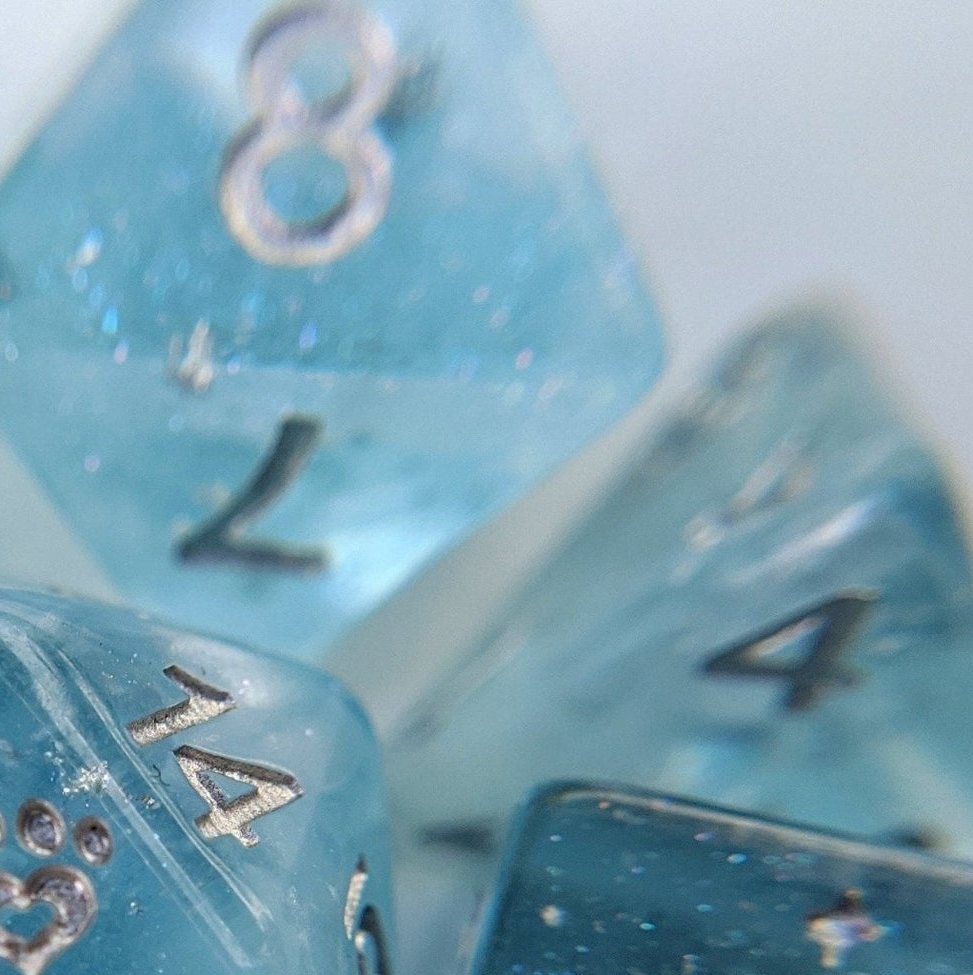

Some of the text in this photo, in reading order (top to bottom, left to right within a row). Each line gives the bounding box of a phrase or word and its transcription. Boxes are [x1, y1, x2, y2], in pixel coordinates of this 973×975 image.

[219, 0, 400, 267] 8
[175, 414, 331, 570] 7
[699, 590, 875, 714] 4
[129, 664, 304, 847] 14
